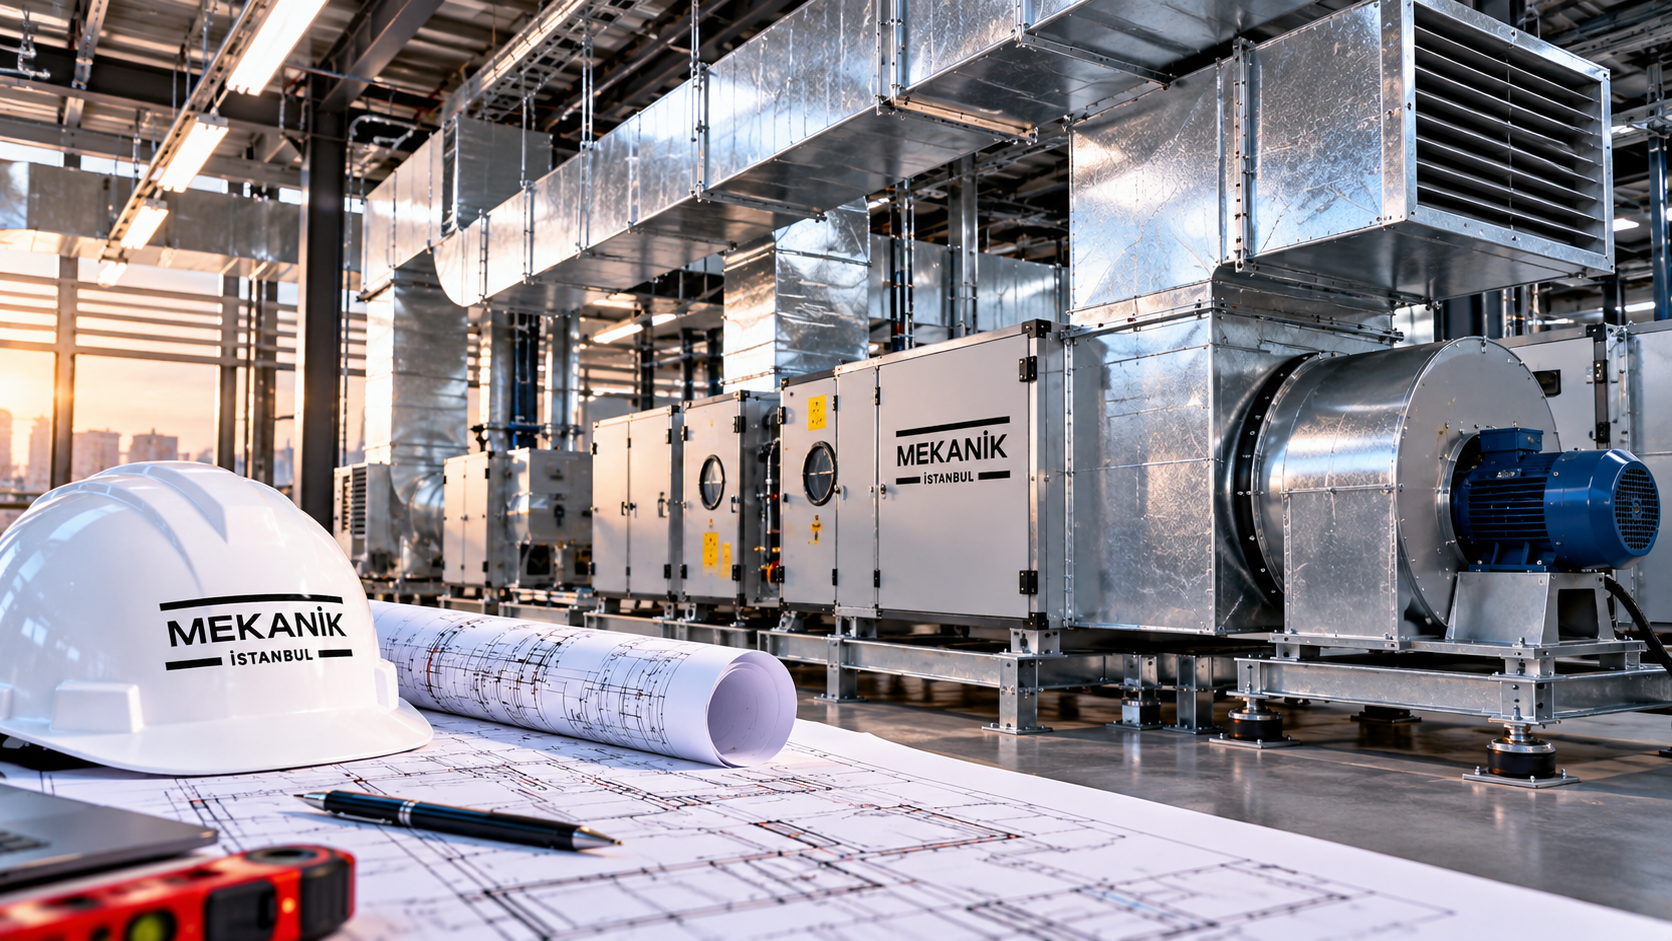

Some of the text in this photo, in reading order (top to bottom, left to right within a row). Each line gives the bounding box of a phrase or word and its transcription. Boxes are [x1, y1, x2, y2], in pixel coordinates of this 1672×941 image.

[897, 430, 1008, 467] MEKANİK
[924, 471, 974, 485] İSTANBUL
[167, 606, 347, 647] MEKANİK
[230, 649, 313, 666] İSTANBUL
